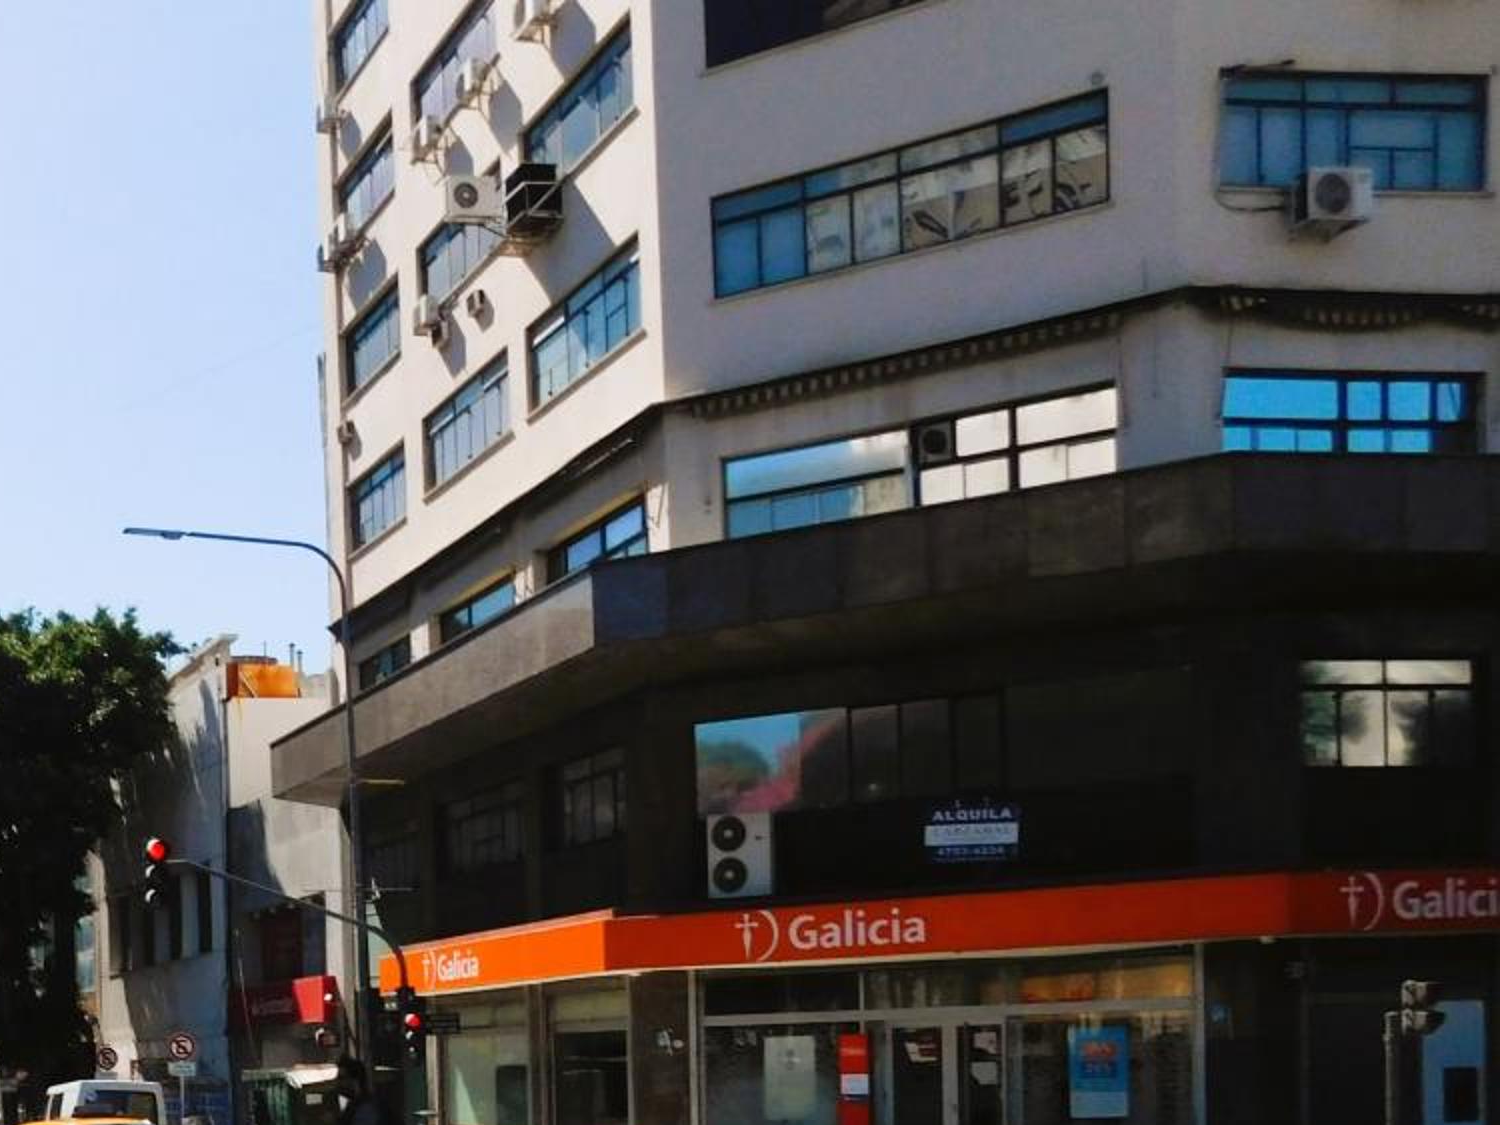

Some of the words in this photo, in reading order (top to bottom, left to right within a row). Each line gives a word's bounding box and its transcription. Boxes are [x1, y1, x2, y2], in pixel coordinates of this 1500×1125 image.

[932, 807, 1013, 822] ALQUILA
[787, 907, 927, 950] Galicia
[437, 949, 480, 982] Galicia
